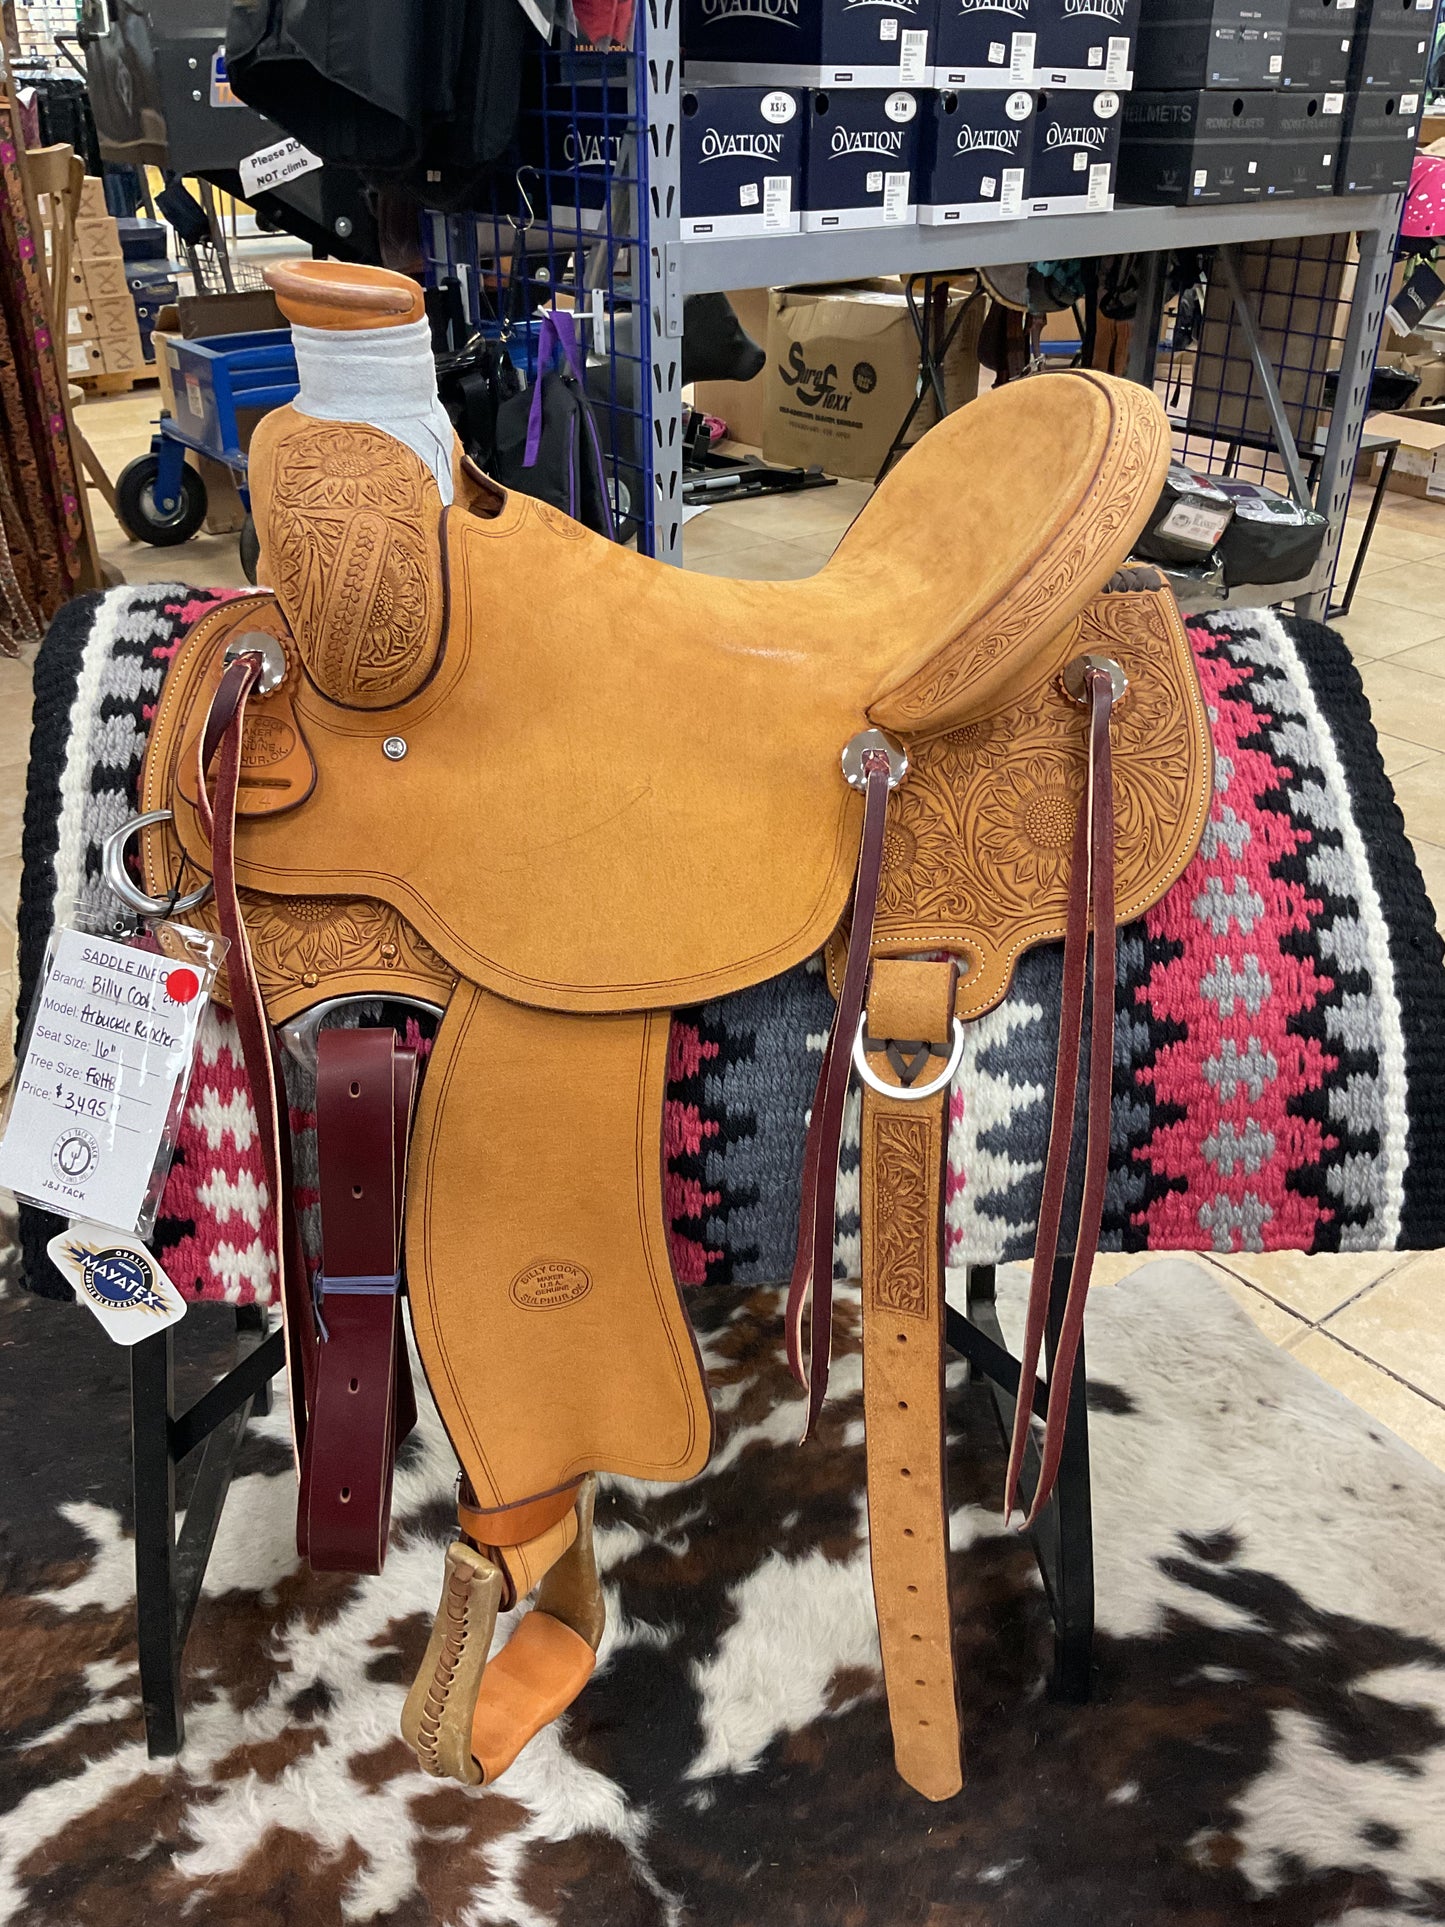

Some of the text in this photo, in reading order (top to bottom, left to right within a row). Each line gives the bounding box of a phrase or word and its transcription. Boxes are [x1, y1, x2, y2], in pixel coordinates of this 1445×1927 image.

[702, 0, 799, 15] OVATION
[1064, 0, 1126, 16] OVATION
[770, 102, 787, 112] XS/S
[894, 102, 908, 112] S/M
[701, 127, 782, 156] OVATION
[831, 125, 903, 152] OVATION
[956, 123, 1019, 150] OVATION
[1046, 121, 1107, 145] OVATION
[250, 140, 301, 169] Please DO
[256, 158, 308, 187] NOT climb
[778, 341, 824, 386] Sure
[242, 728, 272, 737] AKER
[242, 743, 276, 752] NUINE
[82, 948, 134, 974] SADDLE
[52, 969, 87, 990] Brand:
[91, 975, 123, 1005] Billy
[44, 997, 79, 1019] Model:
[81, 1003, 131, 1034] Arbuckle
[36, 1025, 117, 1058] Seat Size: 16"
[30, 1052, 54, 1071] Tree
[55, 1061, 83, 1080] Size:
[21, 1080, 52, 1101] Price:
[42, 1179, 86, 1200] J&J TACK
[115, 1250, 151, 1275] QUALITY
[548, 1264, 579, 1277] COOK
[80, 1254, 159, 1306] MAYATEX
[85, 1270, 137, 1308] SADDLE BLANKETS
[535, 1284, 569, 1296] GENUINE
[536, 1273, 564, 1283] MAKER
